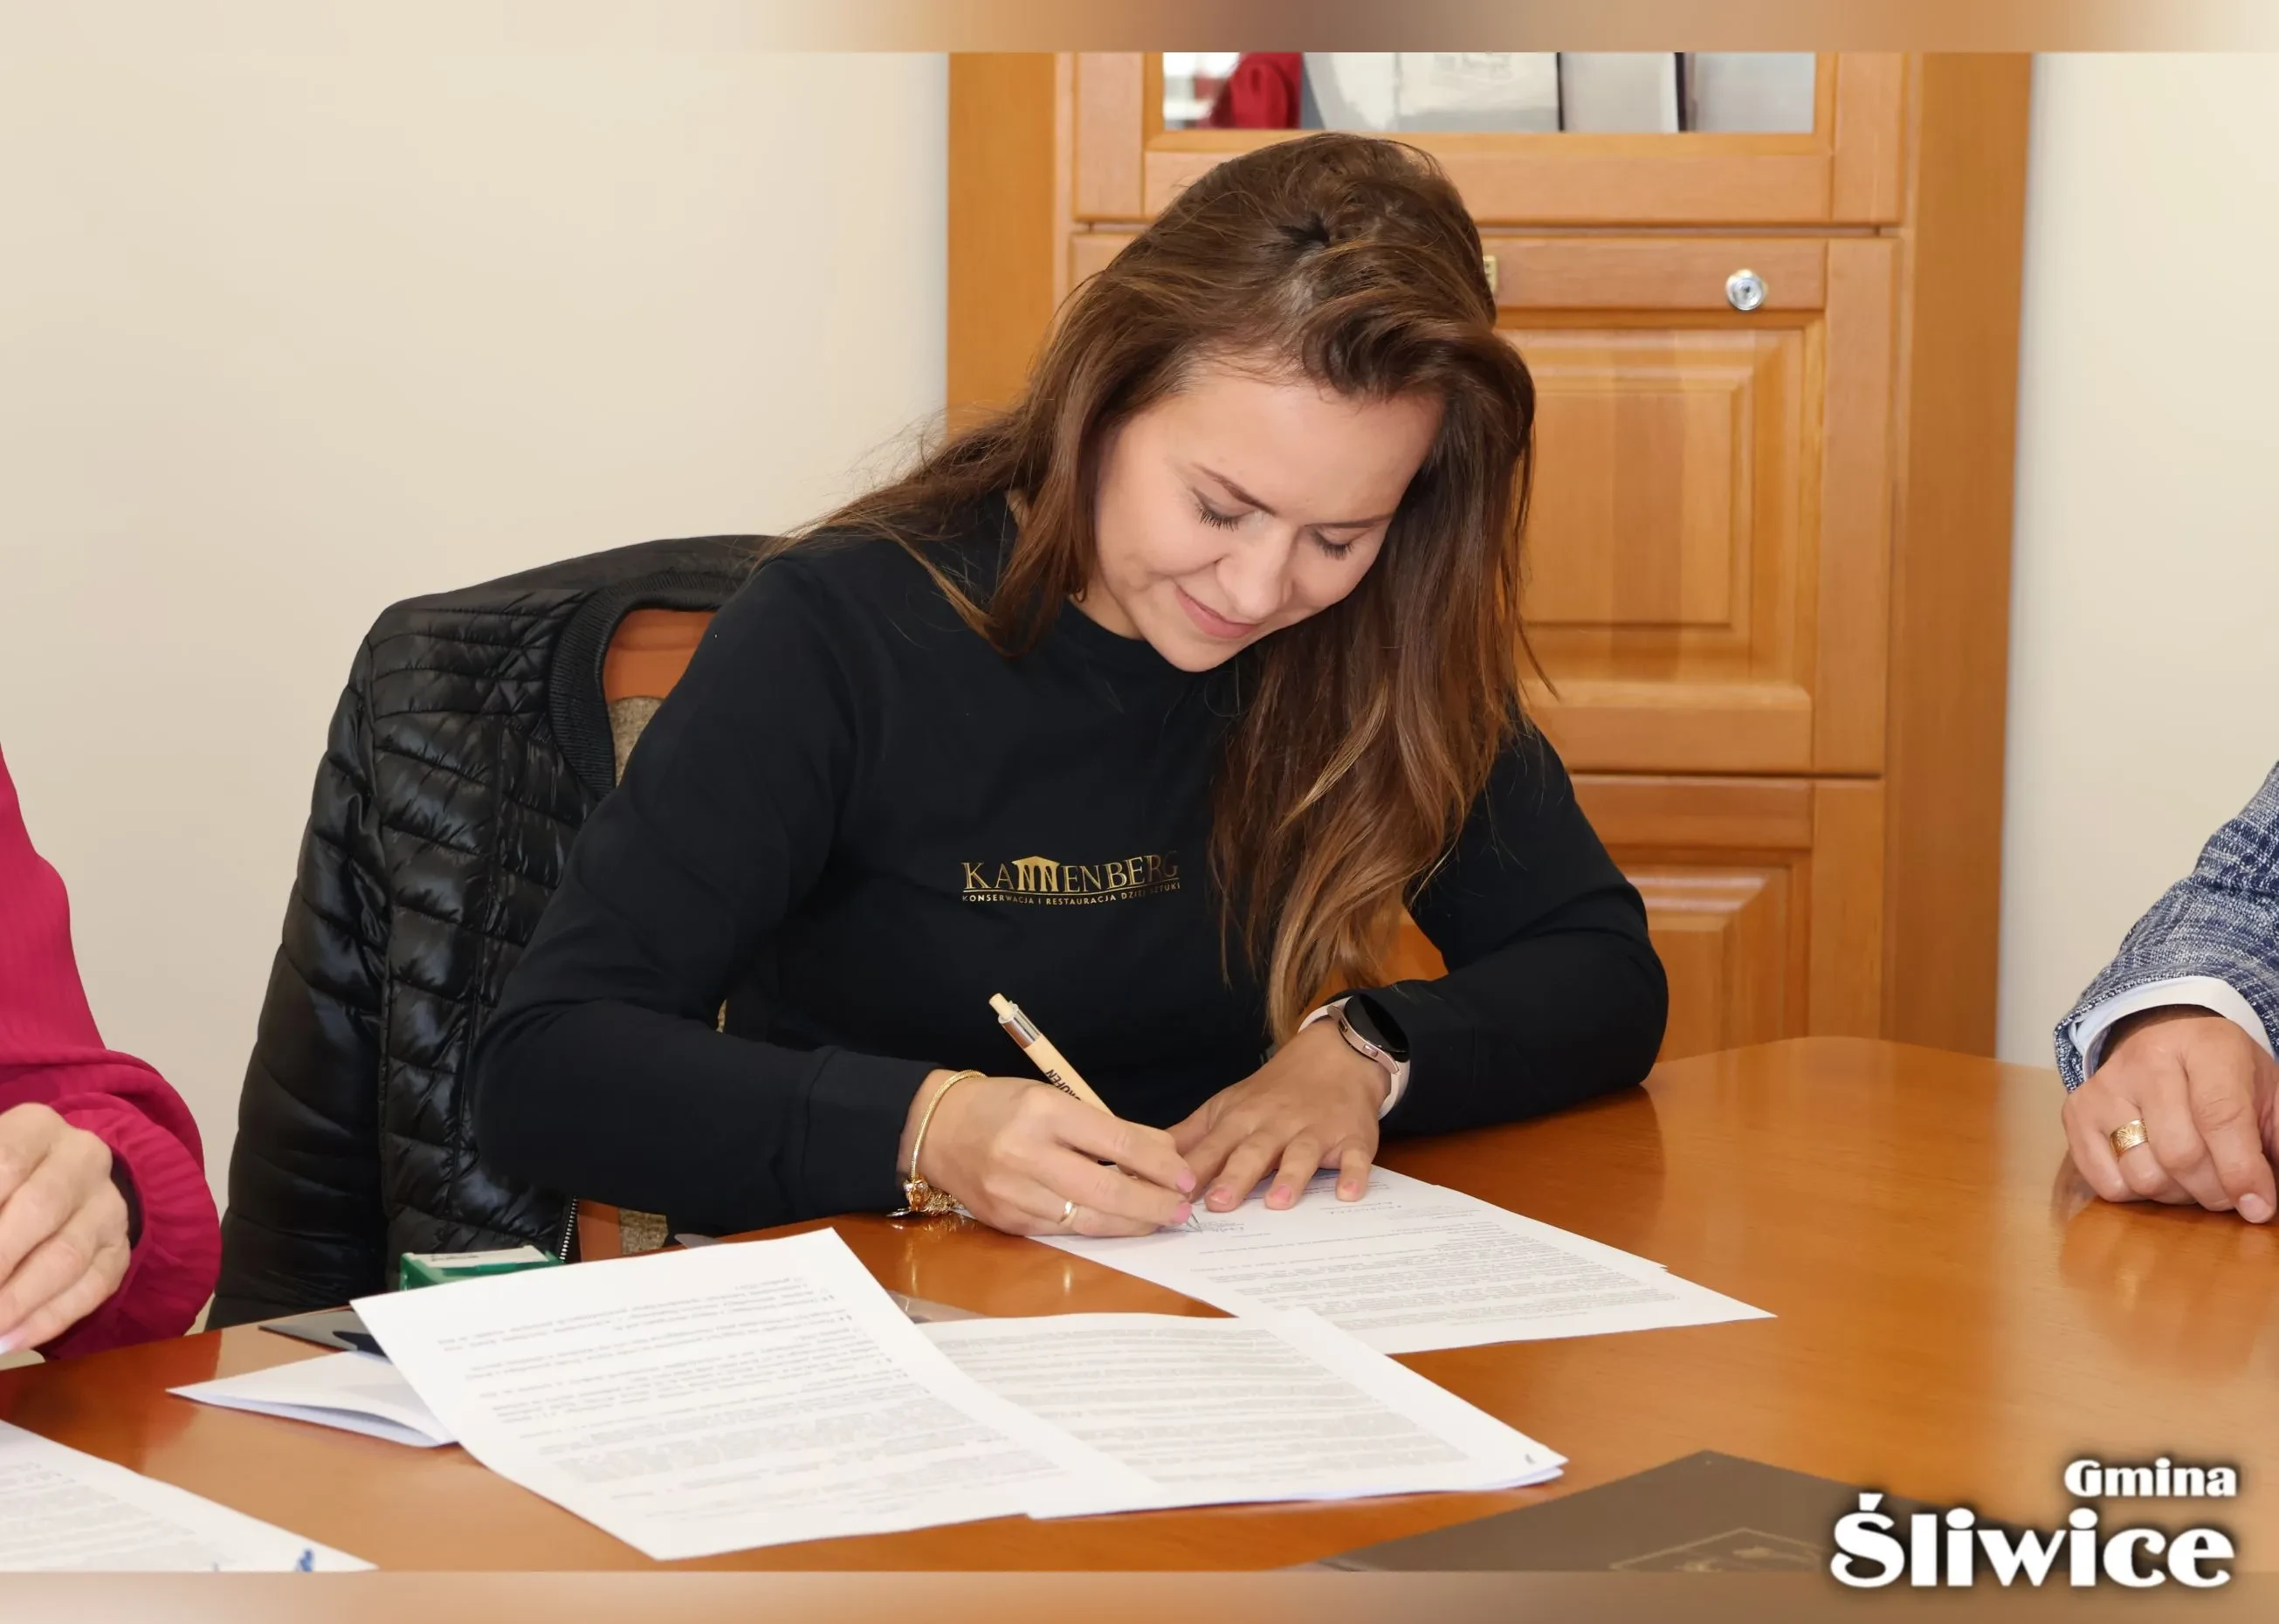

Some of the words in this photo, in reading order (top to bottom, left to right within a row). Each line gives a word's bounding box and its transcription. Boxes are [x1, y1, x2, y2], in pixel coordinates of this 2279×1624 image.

[962, 894, 1035, 905] KONSERWACJA
[1045, 894, 1117, 905] RESTAURACJA
[1150, 882, 1181, 893] ZTUKI
